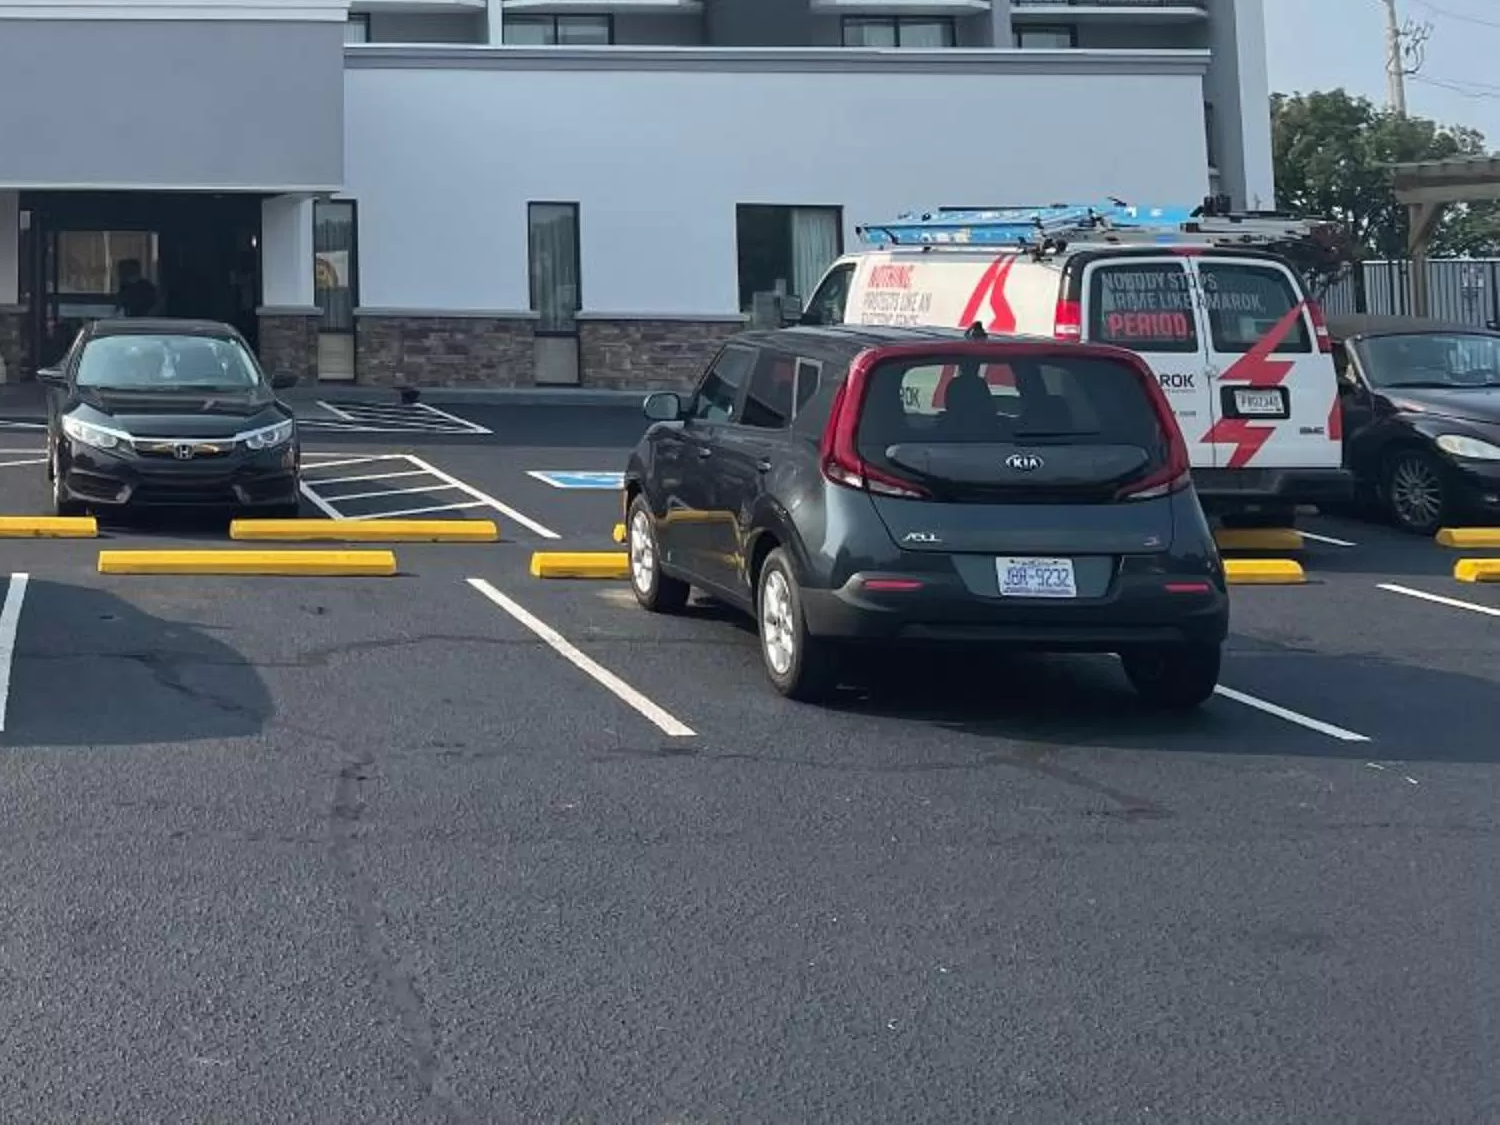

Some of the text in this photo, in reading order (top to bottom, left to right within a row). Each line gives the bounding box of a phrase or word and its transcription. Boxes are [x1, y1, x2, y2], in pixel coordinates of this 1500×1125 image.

[1101, 272, 1218, 291] NOBODY STPS
[1159, 292, 1193, 309] LIKE
[1159, 373, 1195, 388] ROK
[1011, 456, 1041, 469] KIA
